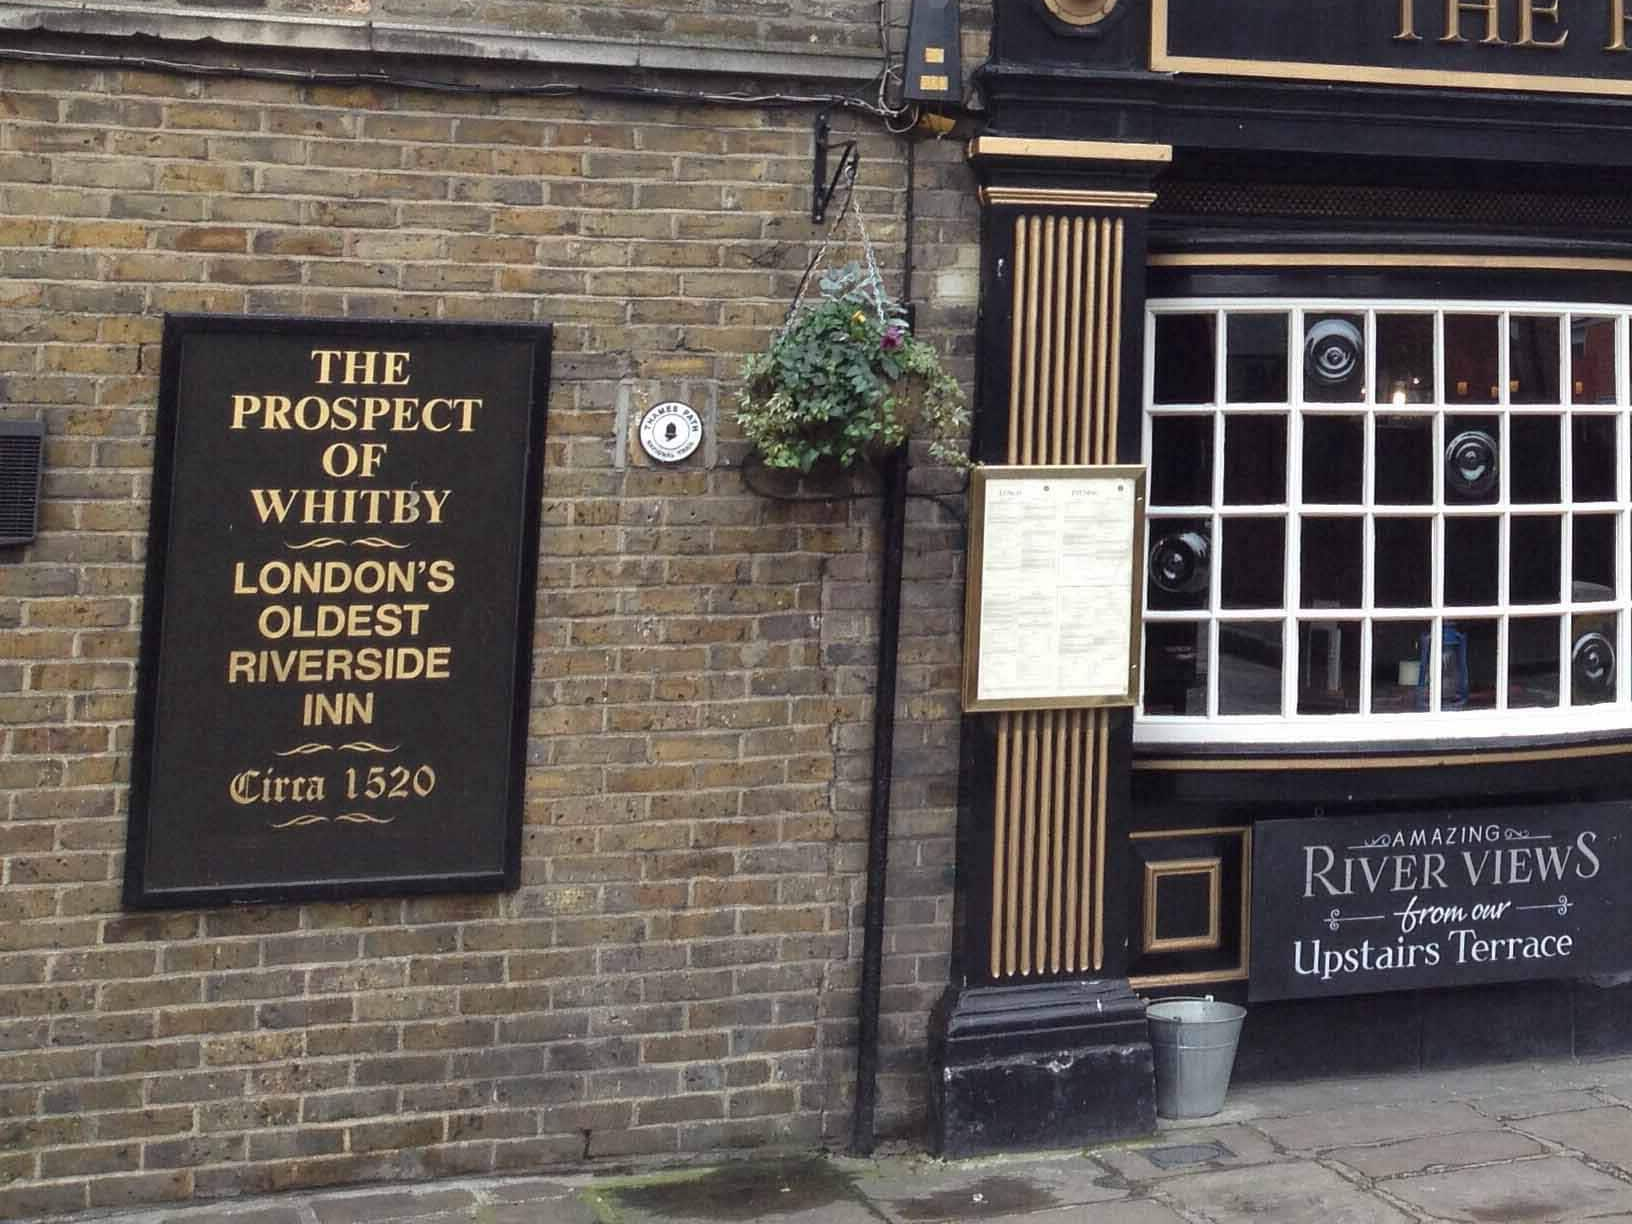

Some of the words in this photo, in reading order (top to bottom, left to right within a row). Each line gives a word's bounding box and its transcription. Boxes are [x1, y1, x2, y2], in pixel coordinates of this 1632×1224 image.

[311, 350, 411, 385] THE
[230, 394, 483, 433] PROSPECT
[683, 409, 699, 432] PATH
[322, 442, 388, 478] OF
[251, 488, 452, 525] WHITBY
[233, 560, 456, 595] LONDON'S
[258, 604, 429, 640] OLDEST
[228, 647, 452, 684] RIVERSIDE
[303, 692, 375, 727] INN
[228, 767, 326, 806] Circa
[344, 764, 436, 800] 1520
[1392, 824, 1500, 848] AMAZING
[1302, 845, 1449, 899] RIVER
[1461, 831, 1600, 887] VIEWS
[1394, 896, 1468, 933] from
[1472, 899, 1511, 923] our
[1294, 936, 1440, 981] Upstairs
[1447, 929, 1573, 966] Terrace
